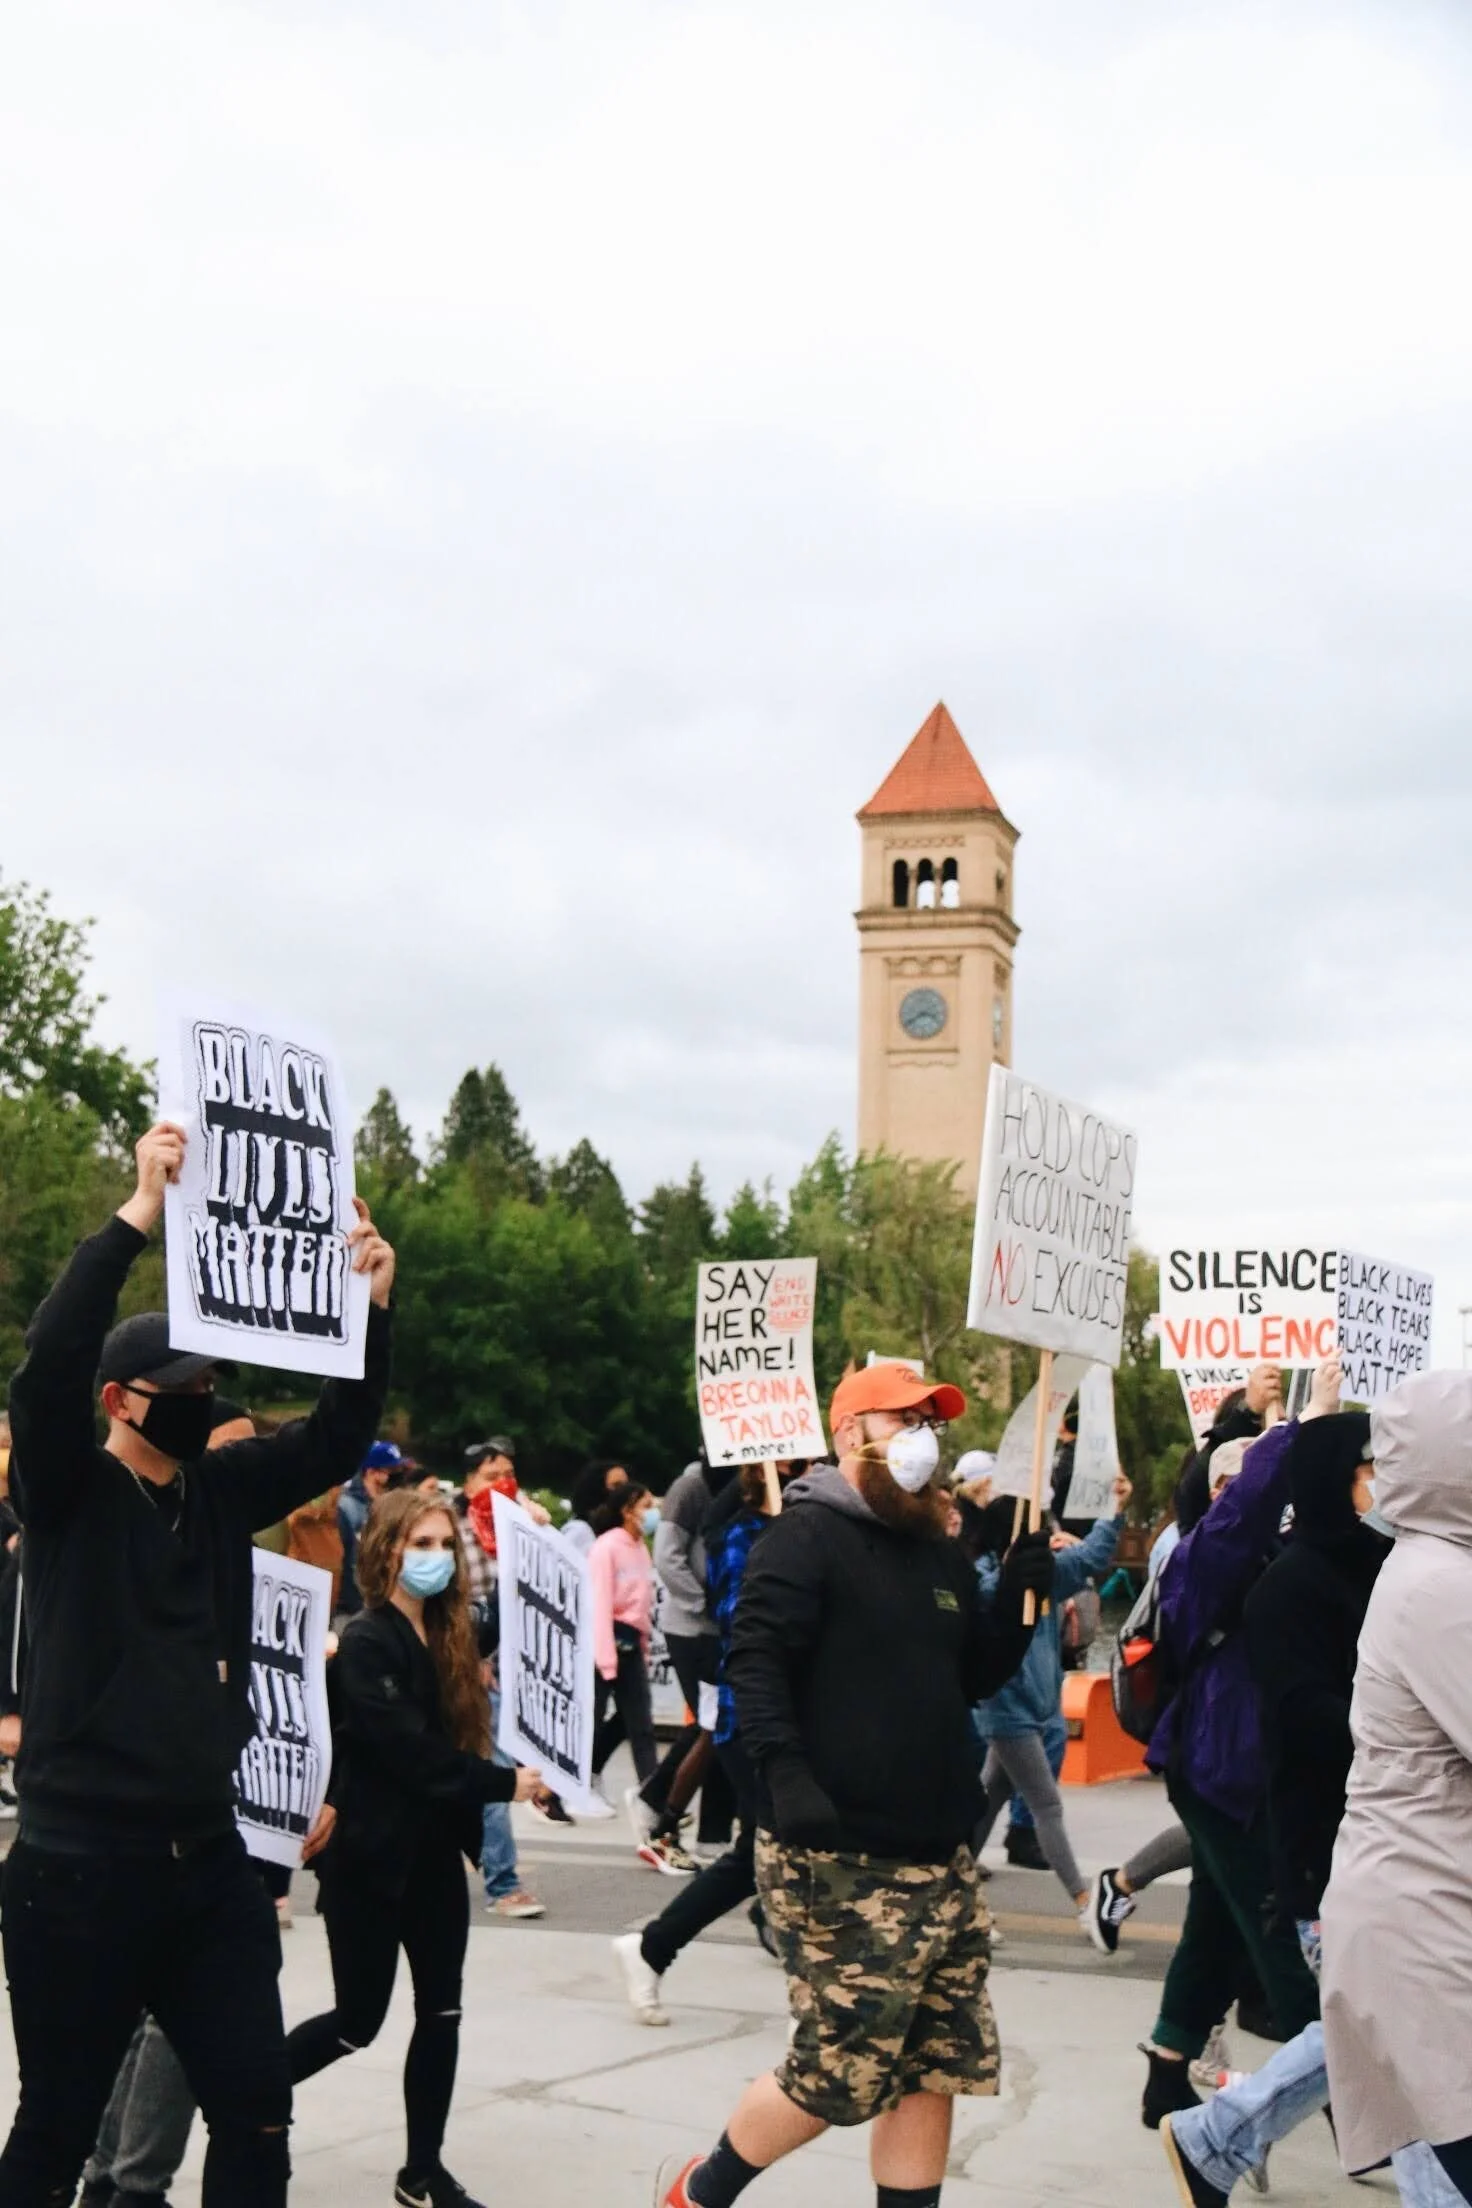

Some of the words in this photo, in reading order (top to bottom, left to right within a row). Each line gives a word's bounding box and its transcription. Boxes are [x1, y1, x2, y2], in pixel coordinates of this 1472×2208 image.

[198, 1027, 333, 1132] BLACK
[1002, 1080, 1072, 1173] HOLD
[1078, 1113, 1137, 1198] COPS
[205, 1122, 333, 1225] LIVES
[994, 1165, 1132, 1267] ACCOUNTABLE
[188, 1211, 345, 1319] MATTER
[705, 1266, 775, 1304] SAY
[985, 1235, 1027, 1309] NO
[1032, 1248, 1126, 1330] EXCUSES
[1168, 1249, 1337, 1293] SILENCE
[1340, 1255, 1391, 1294] BLACK
[1396, 1275, 1433, 1306] LIVES
[703, 1308, 767, 1342] HER
[1239, 1292, 1262, 1315] IS
[1337, 1292, 1385, 1326] BLACK
[1391, 1305, 1430, 1341] TEARS
[699, 1337, 795, 1379] NAME!
[1165, 1315, 1335, 1360] VIOLENC
[1337, 1326, 1382, 1356] BLACK
[1388, 1338, 1423, 1371] HOPE
[702, 1376, 811, 1416] BREONNA
[1341, 1359, 1406, 1397] MATT
[720, 1408, 814, 1443] TAYLOR
[516, 1528, 580, 1627] BLACK
[252, 1578, 306, 1658] ACK
[519, 1596, 575, 1694] LIVES
[250, 1660, 309, 1740] VES
[515, 1662, 584, 1768] MATTER
